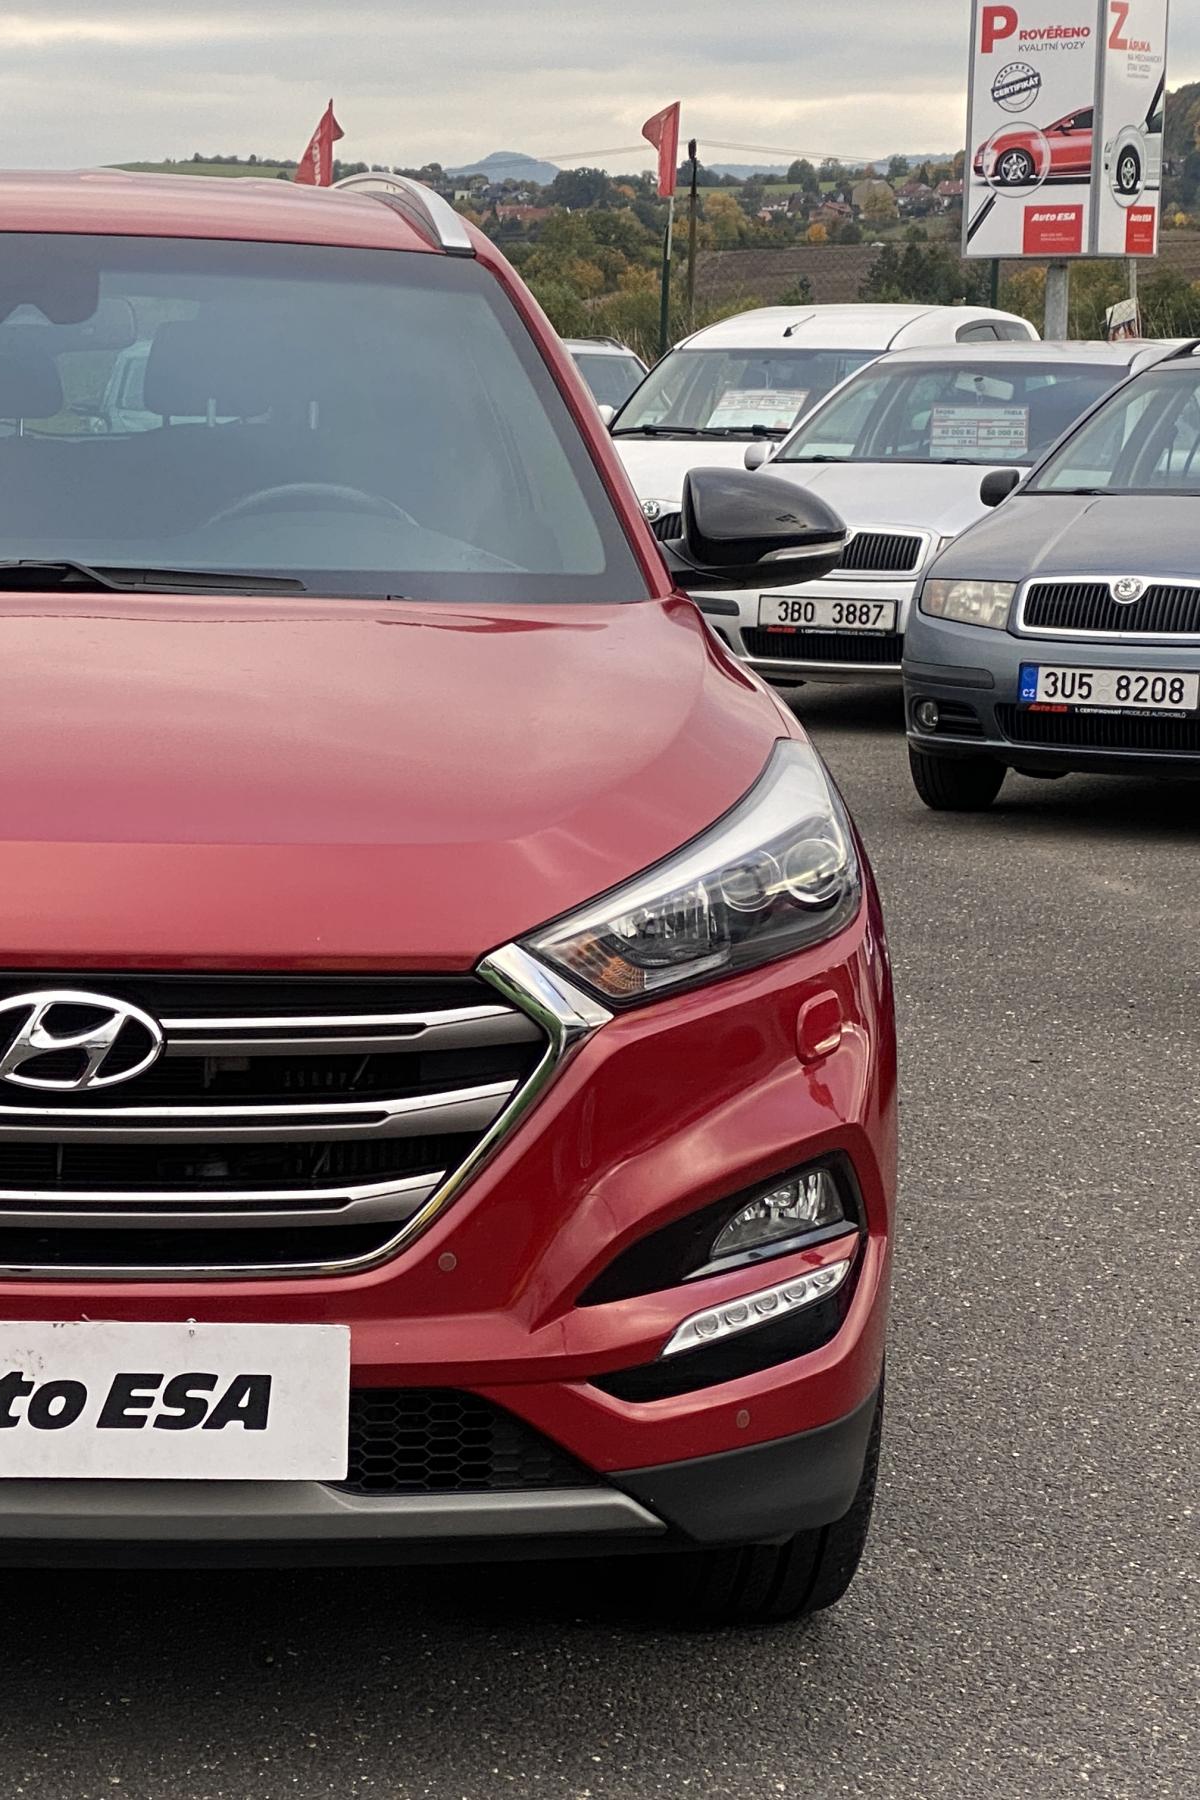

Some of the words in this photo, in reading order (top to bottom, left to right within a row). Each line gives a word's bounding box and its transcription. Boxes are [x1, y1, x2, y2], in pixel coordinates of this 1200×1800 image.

[1018, 41, 1059, 53] KVALITNÍ
[1060, 40, 1086, 51] VOZY
[993, 76, 1039, 98] CERTIFIKÁT
[1031, 213, 1057, 222] Auto
[1057, 212, 1076, 221] ESA
[777, 600, 815, 623] 3B0
[832, 602, 884, 626] 3887
[1022, 688, 1035, 697] CZ
[1044, 671, 1094, 700] 3U5
[1115, 675, 1185, 705] 8208
[96, 1372, 273, 1431] ESA
